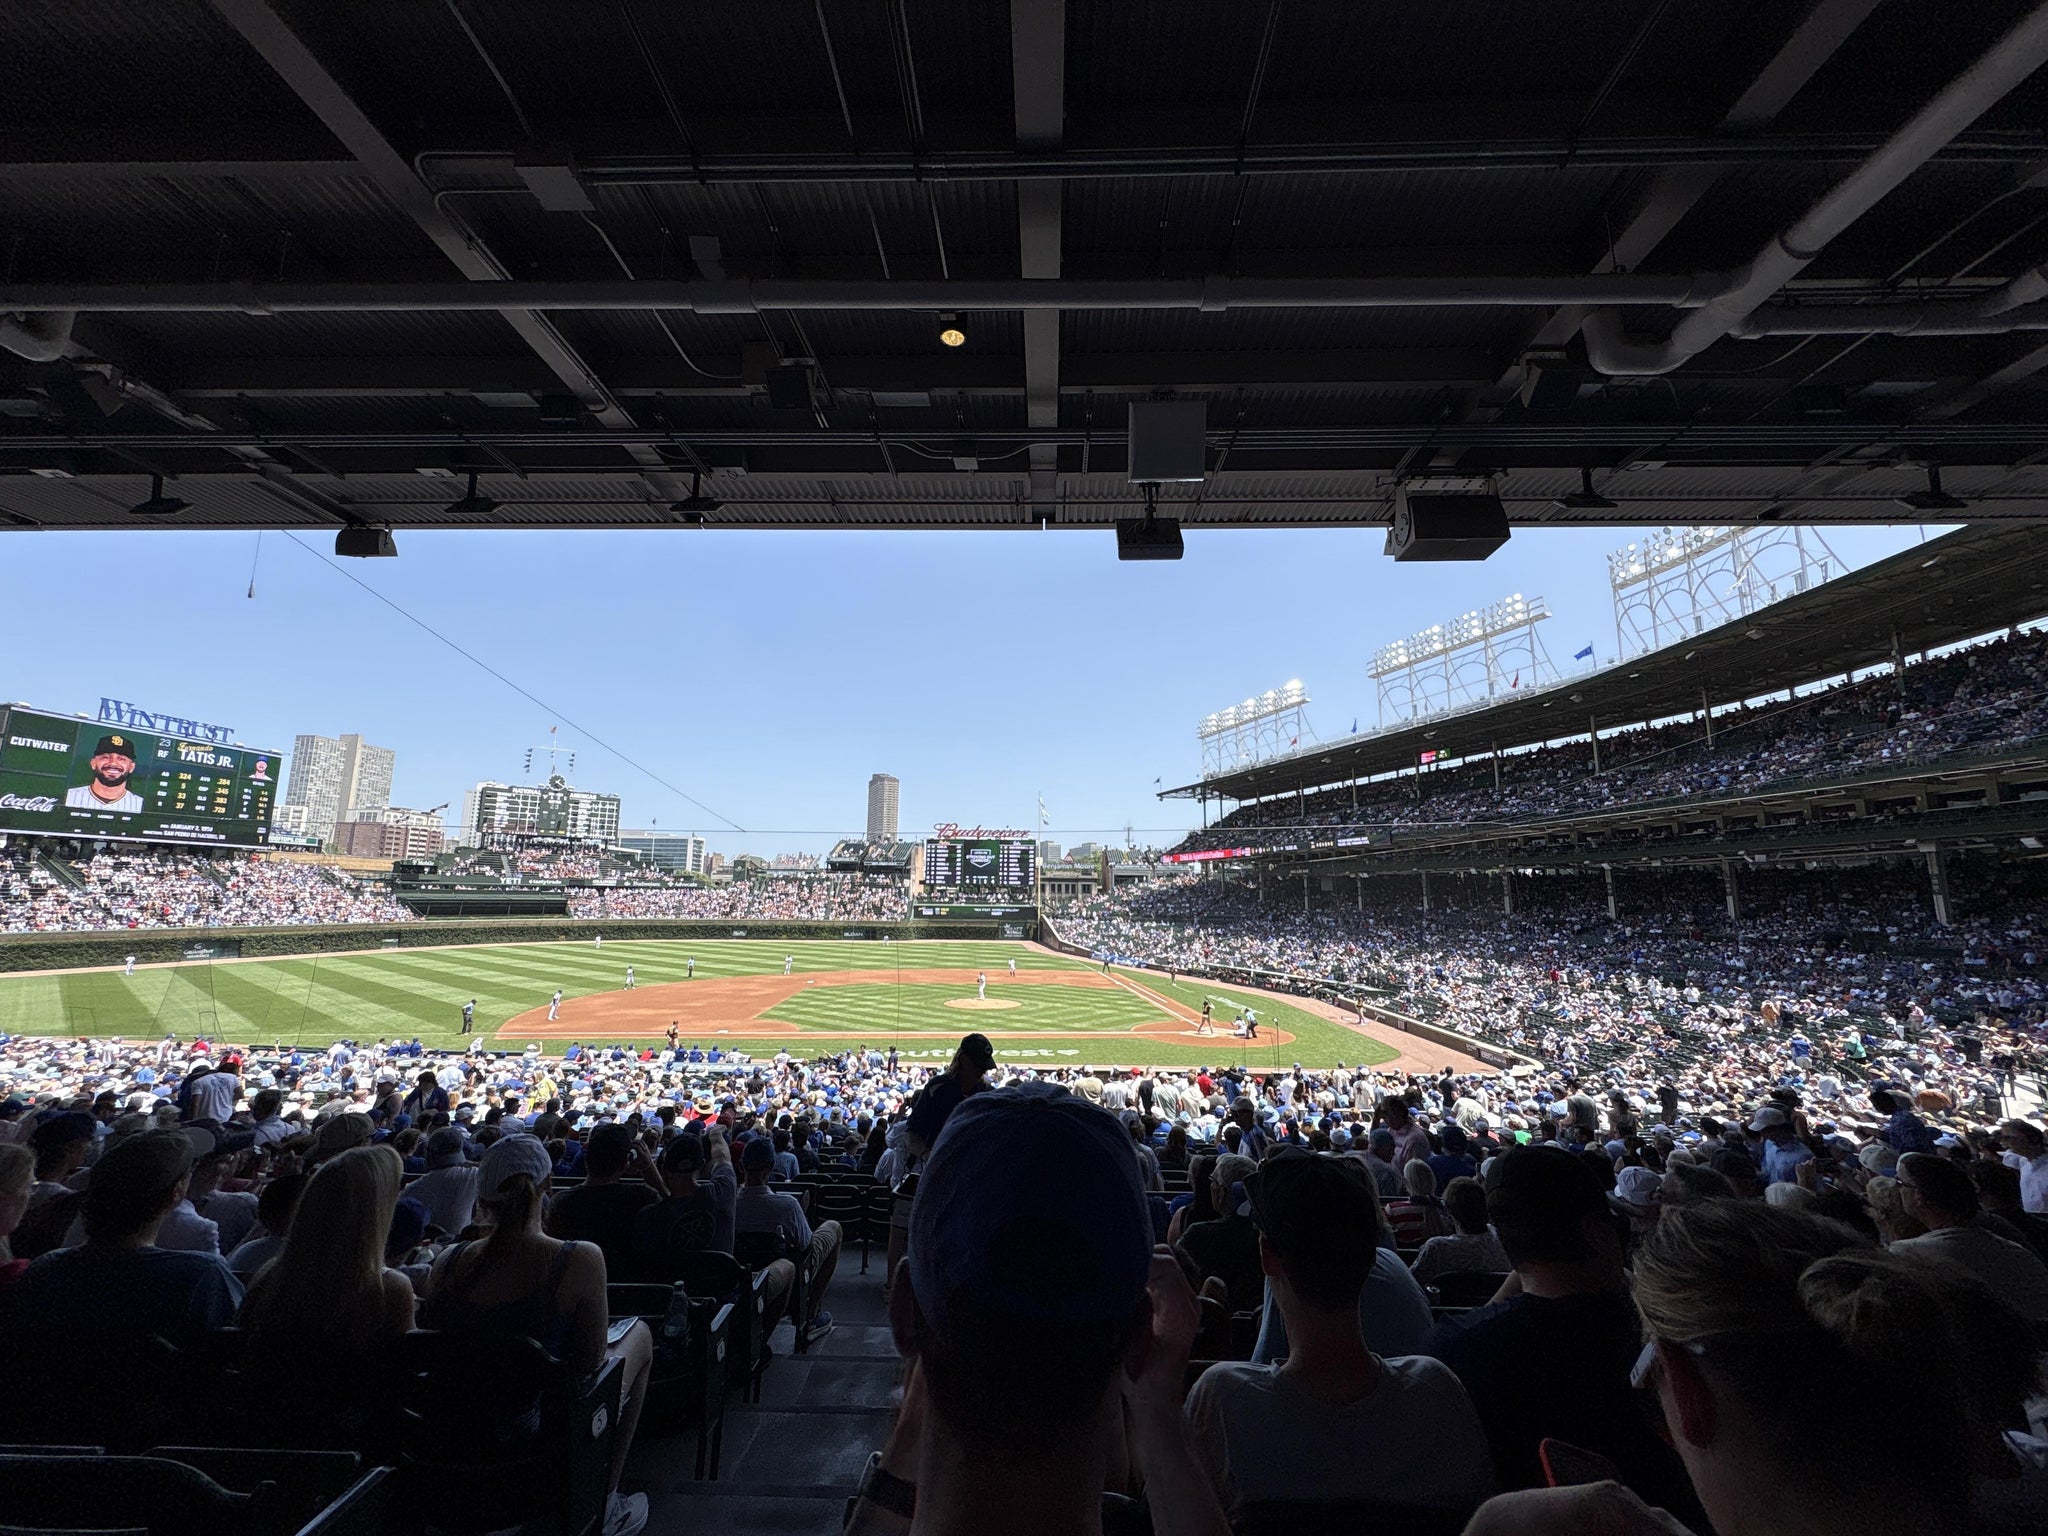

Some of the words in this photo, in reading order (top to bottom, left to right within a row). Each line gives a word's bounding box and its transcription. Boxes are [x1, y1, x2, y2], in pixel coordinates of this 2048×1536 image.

[100, 697, 234, 743] WINTRUST
[10, 736, 68, 752] CUTWATER
[159, 738, 171, 747] 23
[157, 749, 169, 758] RF
[180, 750, 216, 765] TATIS
[216, 755, 234, 768] JR.
[933, 823, 1031, 839] Budweiser
[500, 877, 521, 885] YETI
